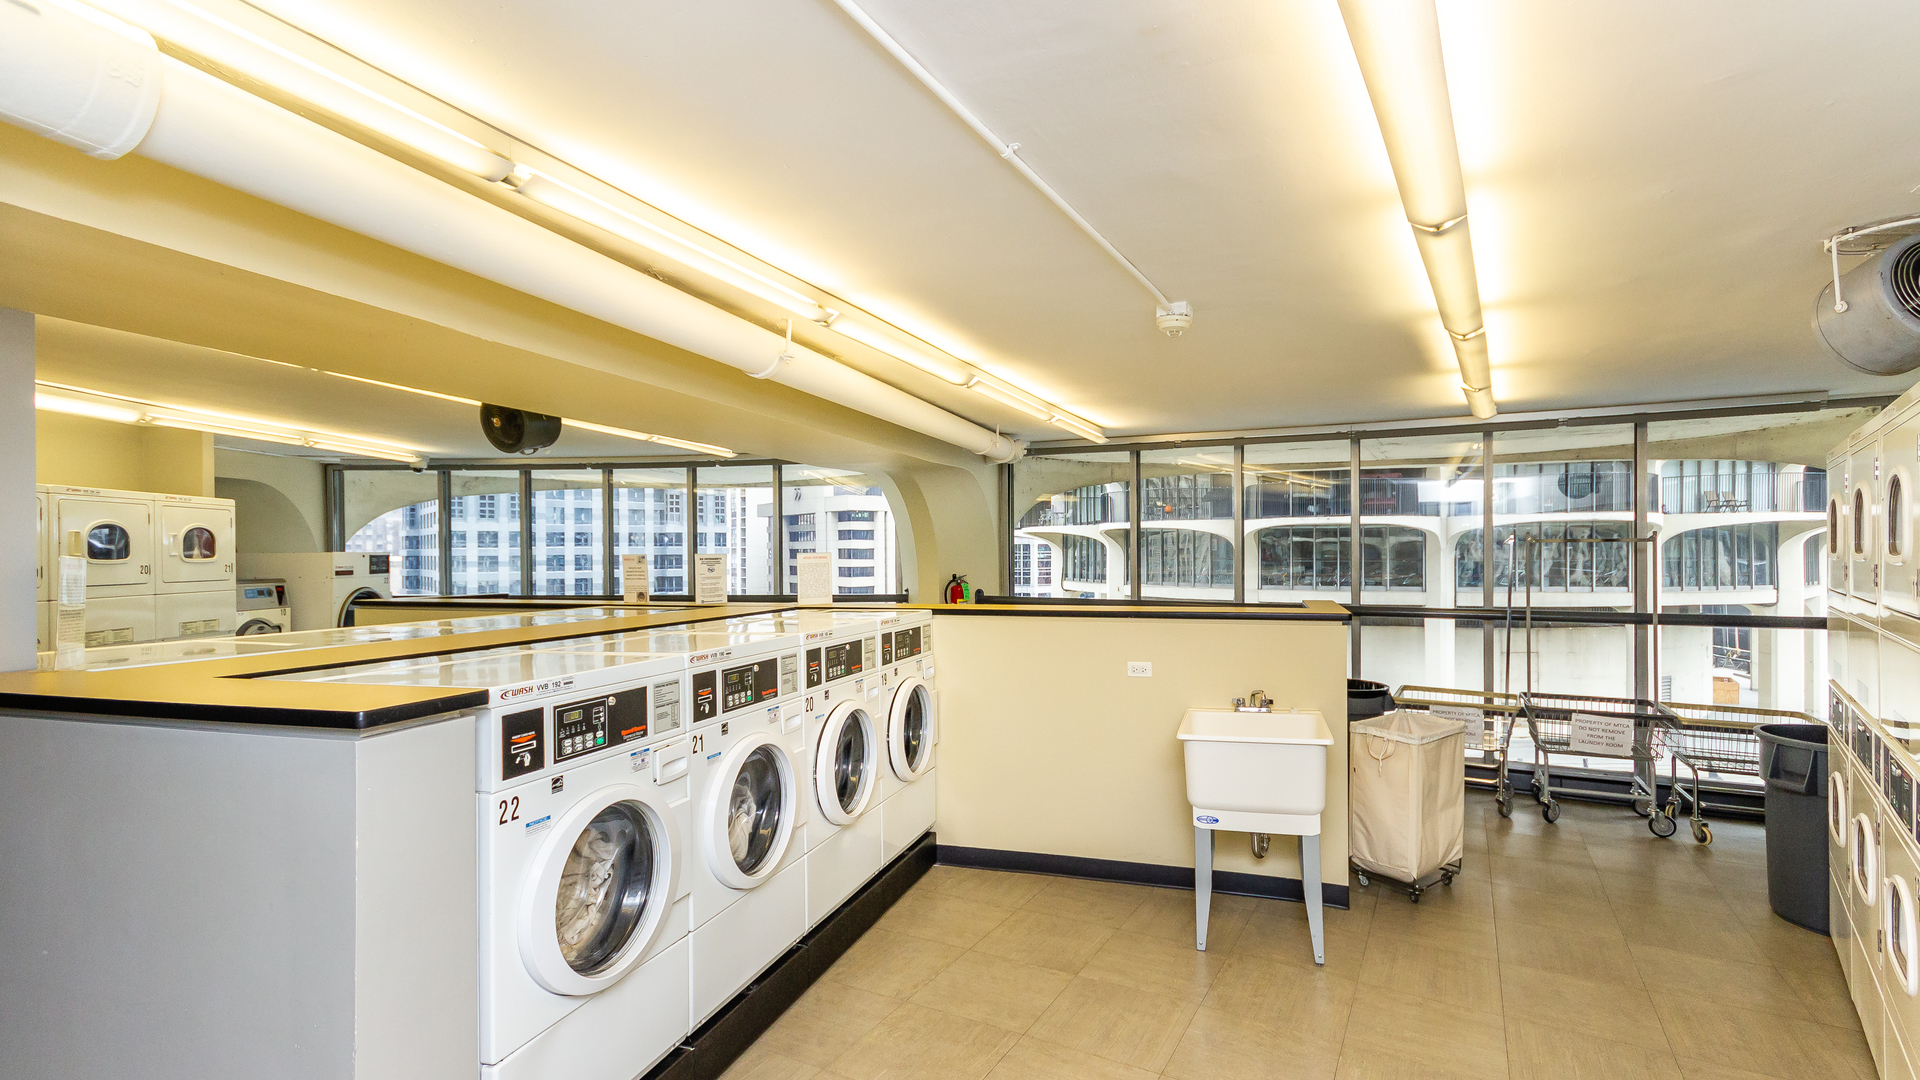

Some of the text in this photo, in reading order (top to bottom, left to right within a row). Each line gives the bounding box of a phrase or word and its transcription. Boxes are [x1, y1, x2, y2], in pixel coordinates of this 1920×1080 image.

[140, 564, 149, 575] 20
[224, 563, 231, 573] 21
[280, 608, 286, 616] 10
[511, 685, 534, 697] WASH
[551, 680, 561, 688] 192
[805, 696, 814, 713] 20
[1575, 718, 1603, 726] PROPERTY
[1601, 728, 1626, 736] REMOVE
[692, 733, 704, 755] 21
[499, 795, 520, 826] 22
